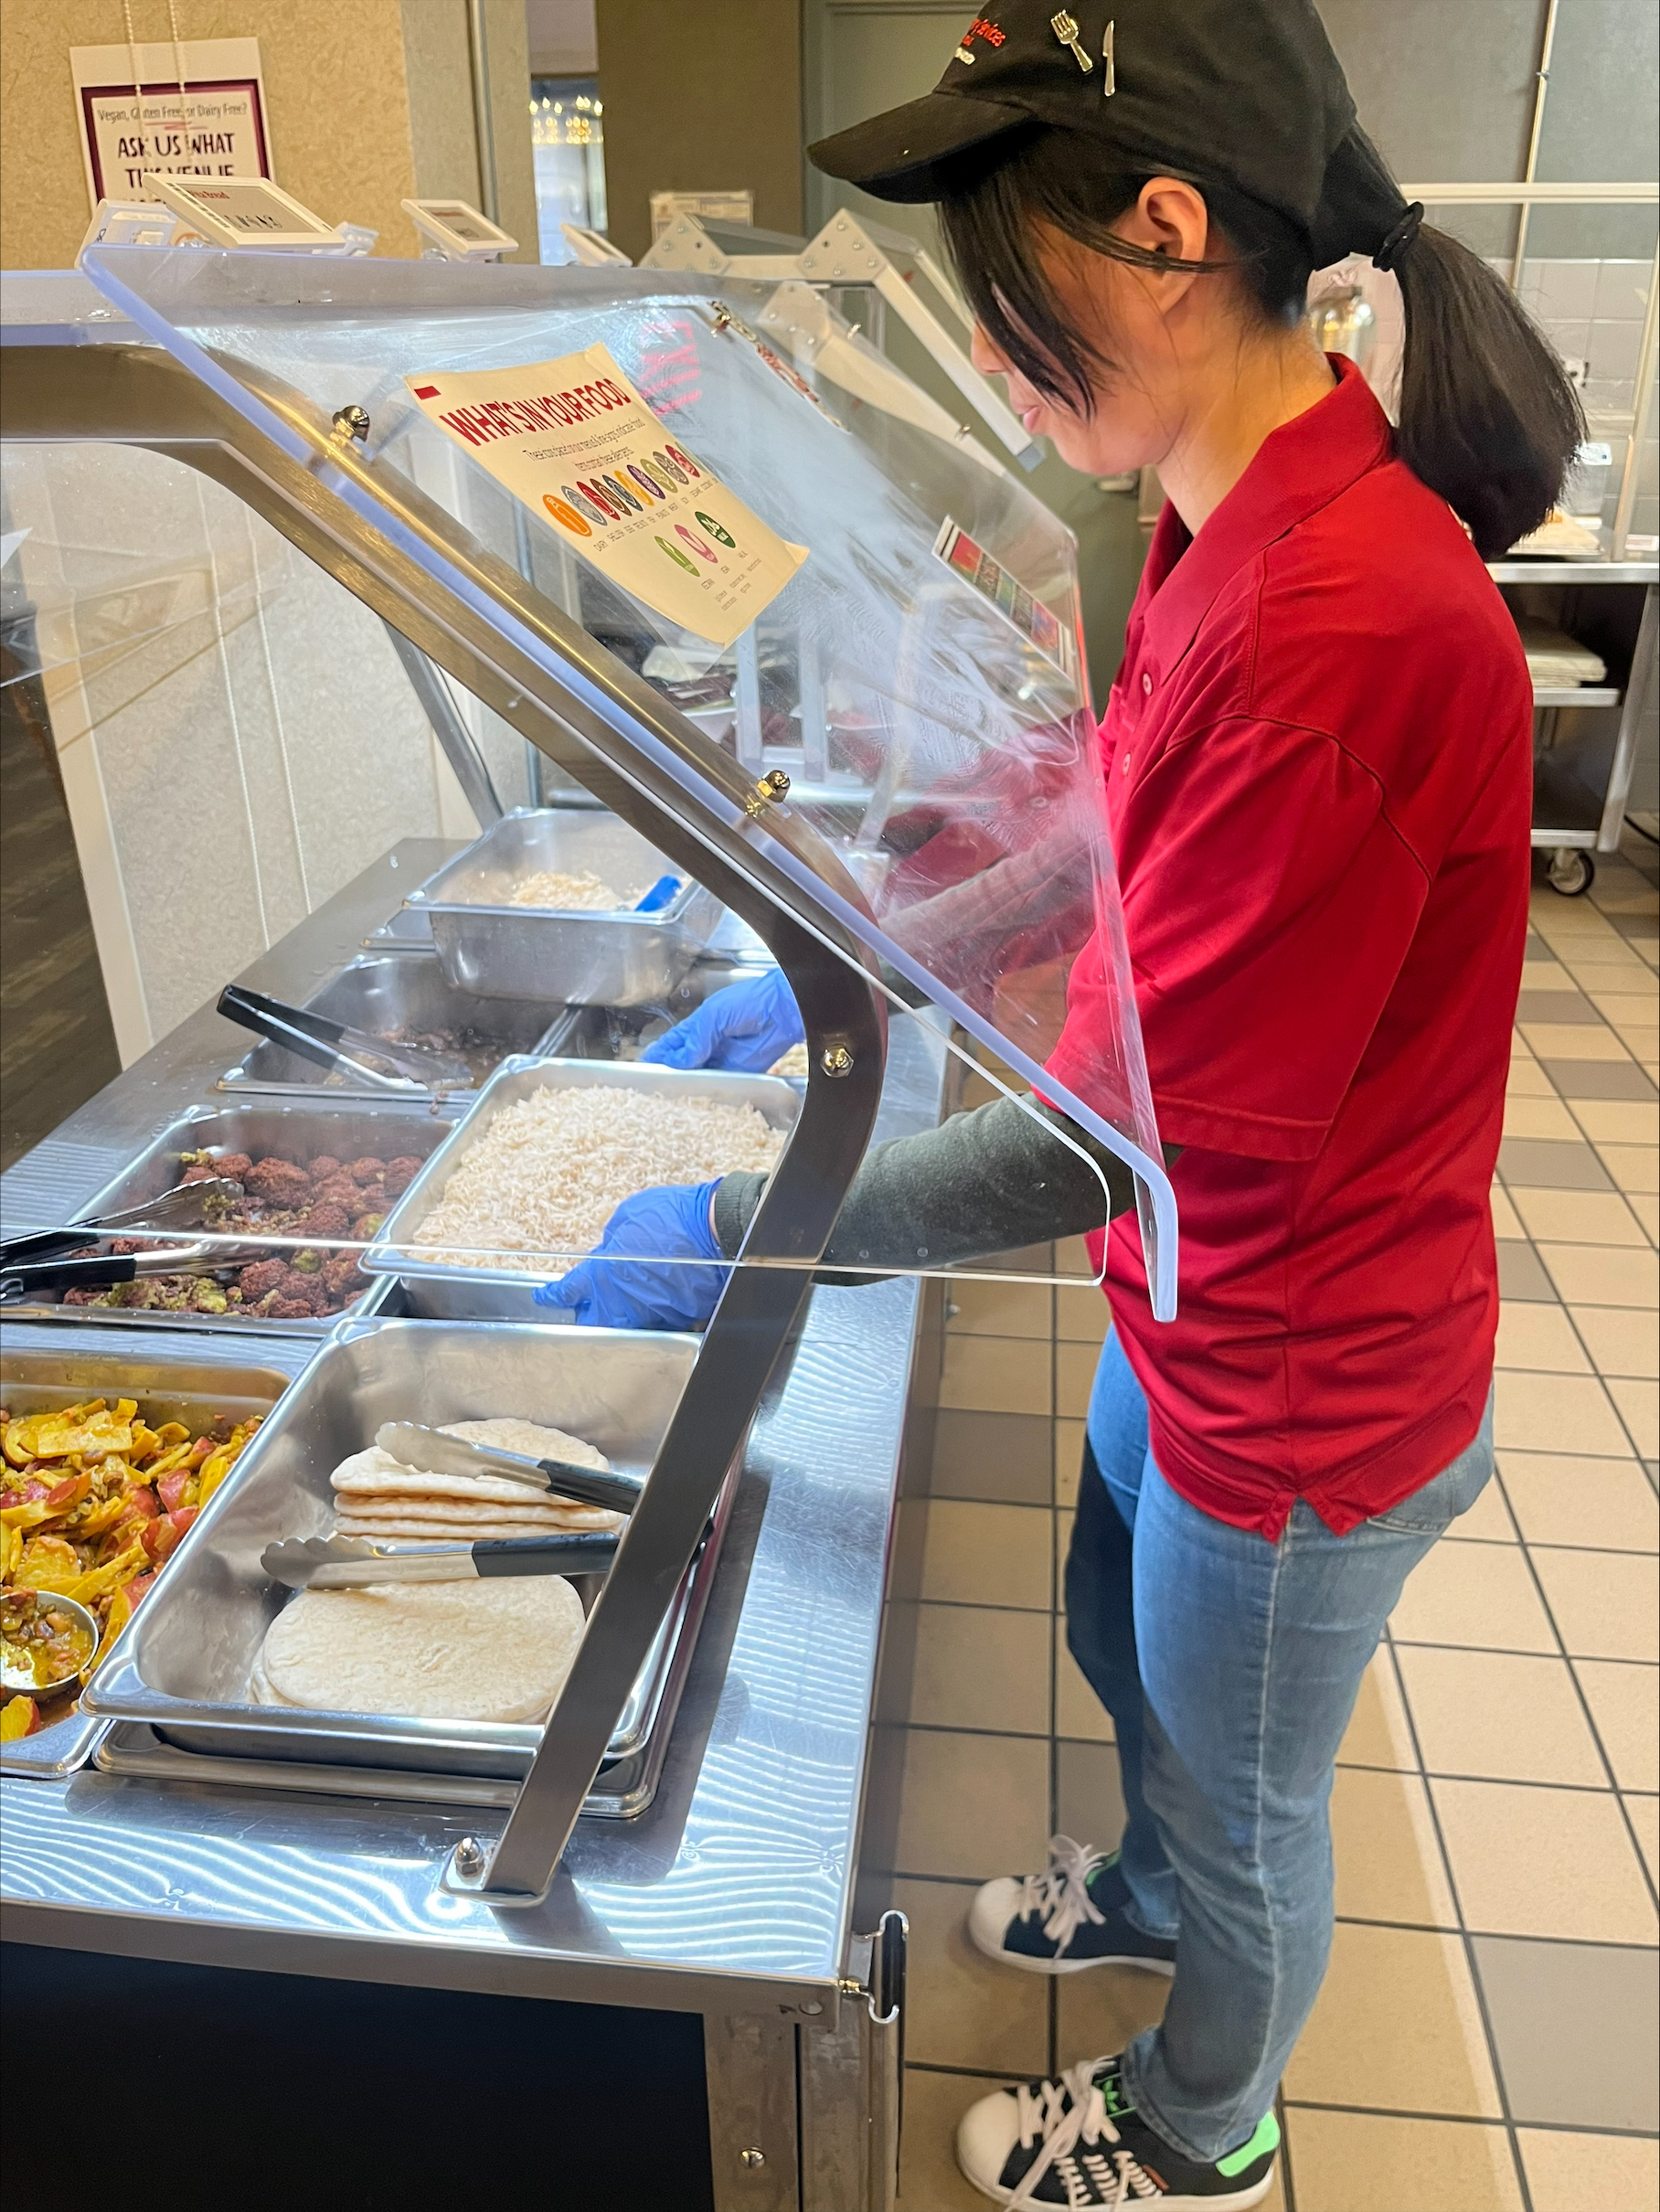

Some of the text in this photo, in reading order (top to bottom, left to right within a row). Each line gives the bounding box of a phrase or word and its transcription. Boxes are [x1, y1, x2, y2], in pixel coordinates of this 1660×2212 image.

[130, 107, 161, 120] Glten
[197, 104, 221, 119] Dairy
[223, 102, 248, 117] Free?
[118, 133, 235, 158] ASK US WHAT
[439, 378, 632, 447] WHAT'S IN YOUR FOOD
